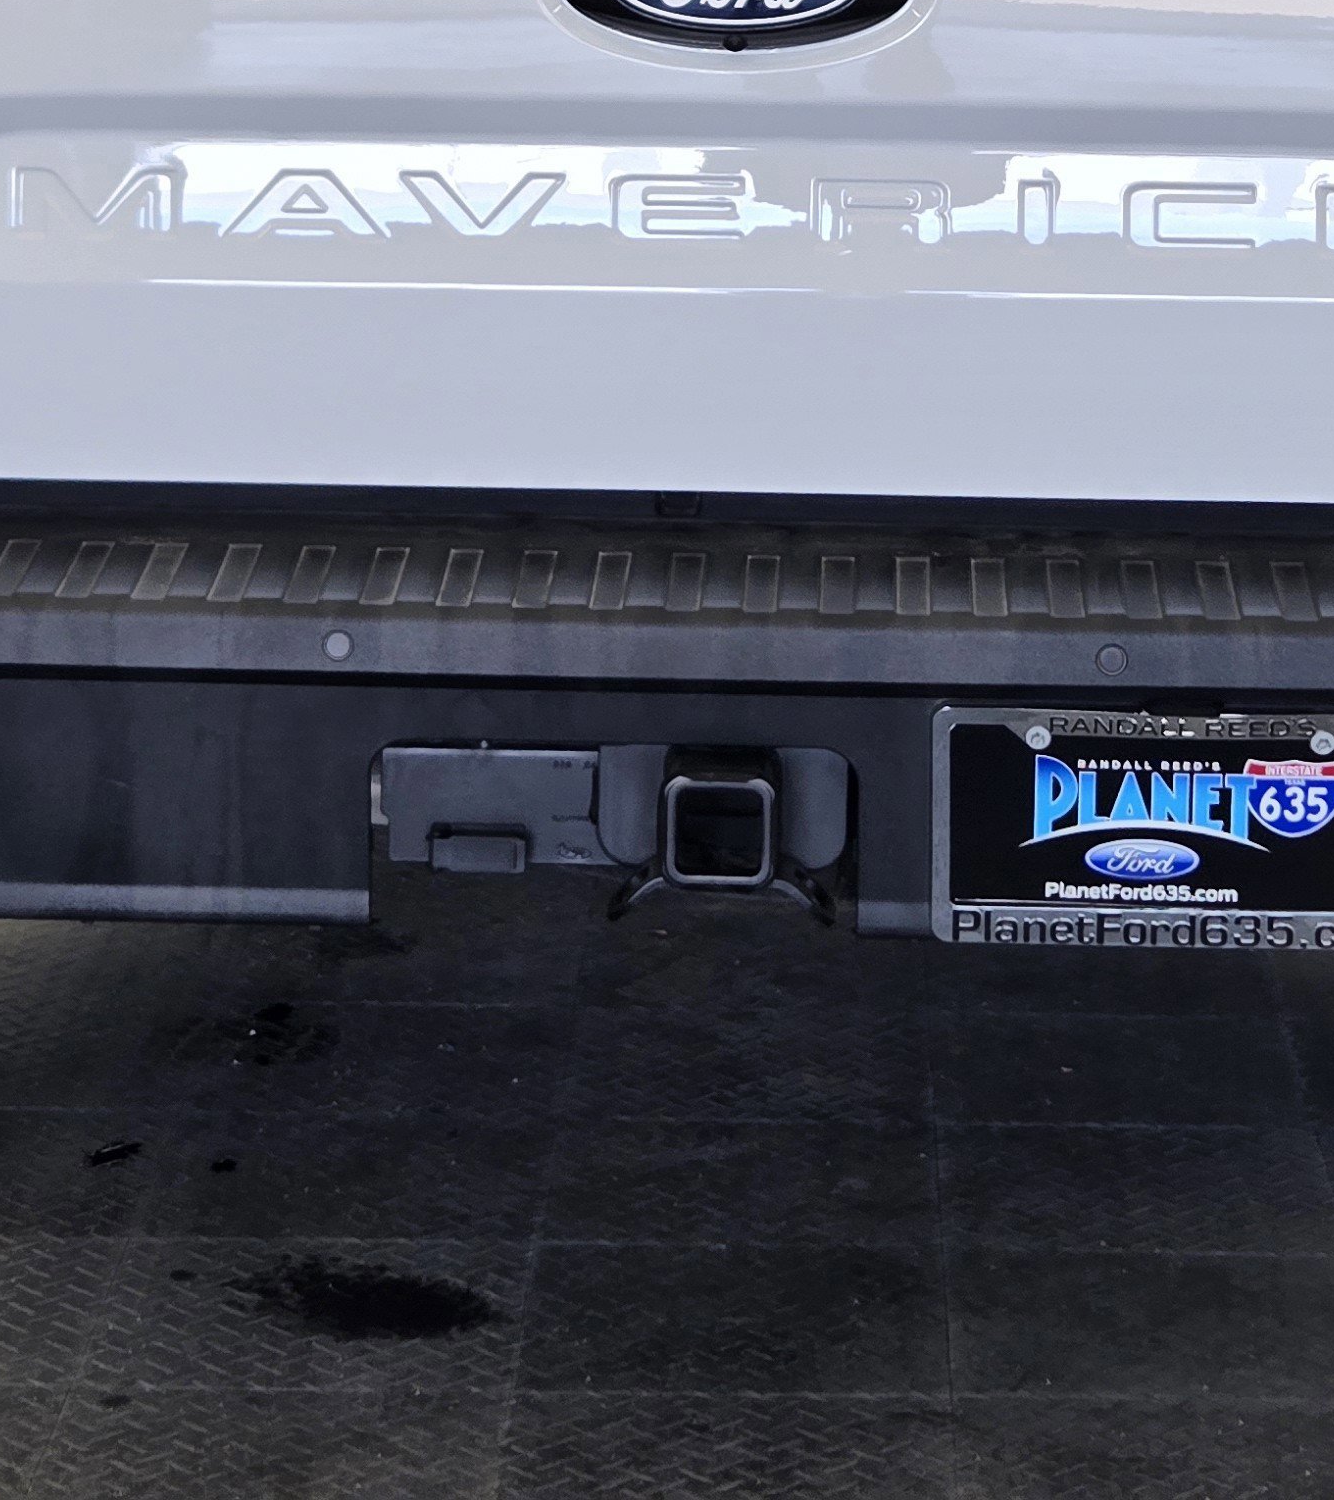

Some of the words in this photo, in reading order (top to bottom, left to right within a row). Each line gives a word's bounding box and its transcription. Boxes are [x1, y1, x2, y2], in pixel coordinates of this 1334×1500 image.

[1049, 716, 1195, 738] RANDALL
[1205, 717, 1317, 739] REED'S
[1077, 759, 1153, 771] RANDALL
[1160, 760, 1221, 772] REED'S
[1033, 754, 1258, 841] PLANET
[1259, 786, 1329, 823] 635
[1107, 844, 1175, 875] Ford
[1044, 881, 1239, 904] PlanetFord635.com
